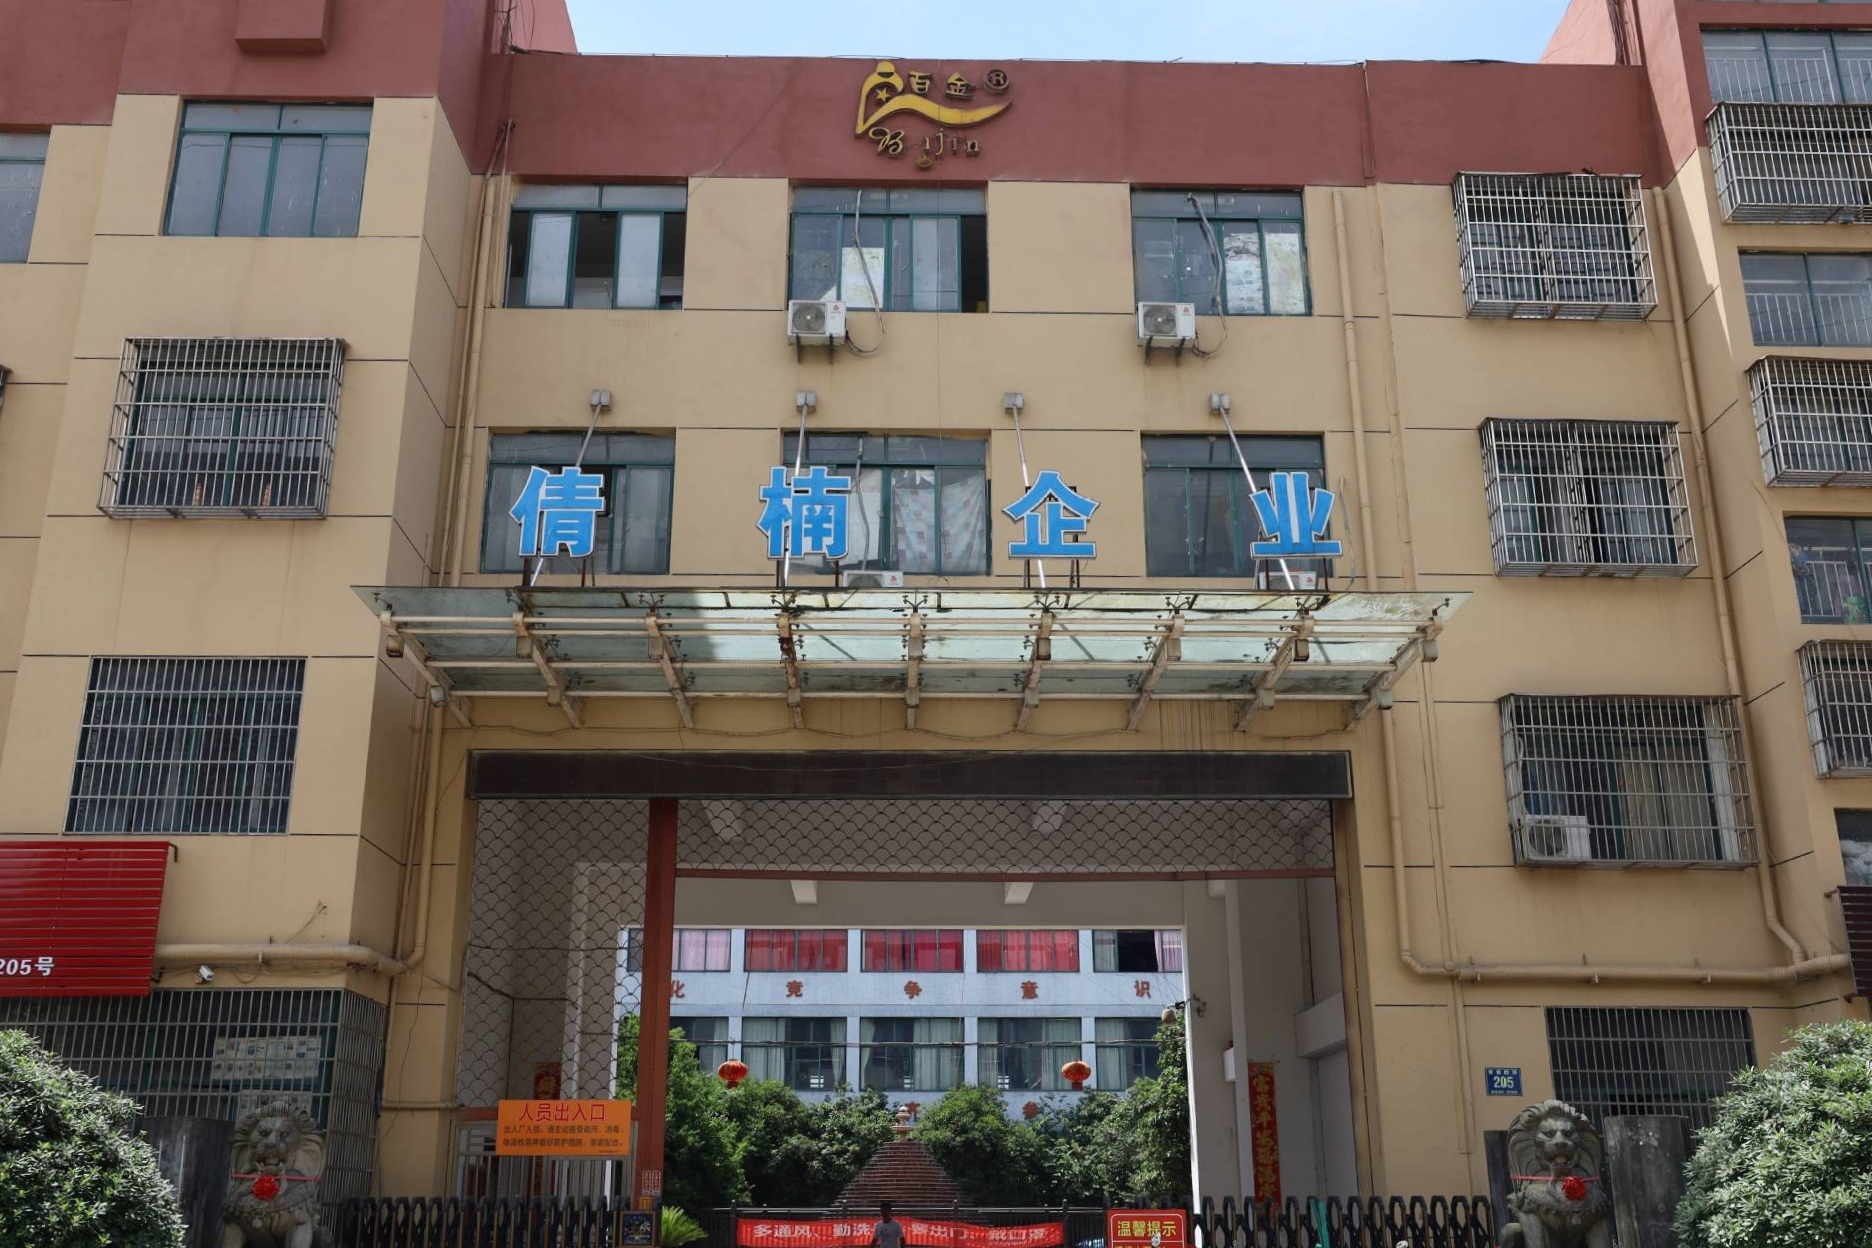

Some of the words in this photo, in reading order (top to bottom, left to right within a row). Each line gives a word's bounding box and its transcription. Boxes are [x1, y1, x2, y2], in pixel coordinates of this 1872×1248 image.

[508, 465, 1343, 559] 倩楠企业
[1493, 1076, 1514, 1089] 205
[518, 1102, 605, 1122] 人员出入口
[1117, 1220, 1177, 1237] 温馨提示
